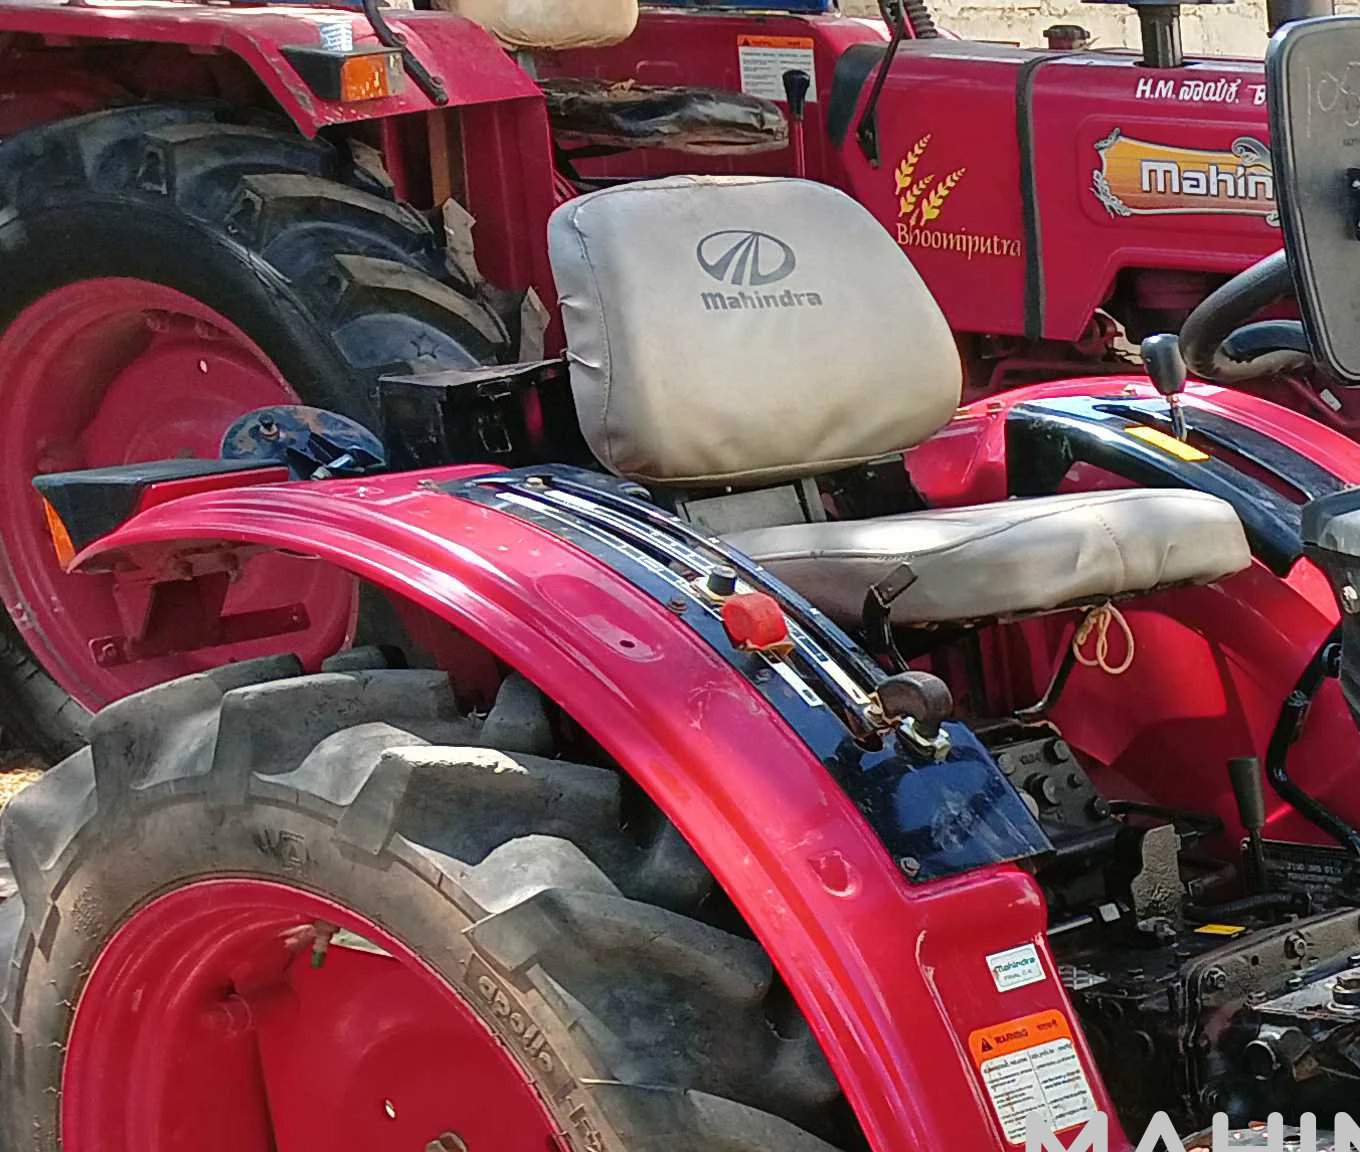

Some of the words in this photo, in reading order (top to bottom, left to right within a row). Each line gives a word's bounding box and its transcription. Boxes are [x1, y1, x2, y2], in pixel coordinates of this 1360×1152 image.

[1141, 160, 1274, 200] Mahin
[895, 214, 1022, 261] Bhoomiputra
[701, 289, 823, 311] Mahindra
